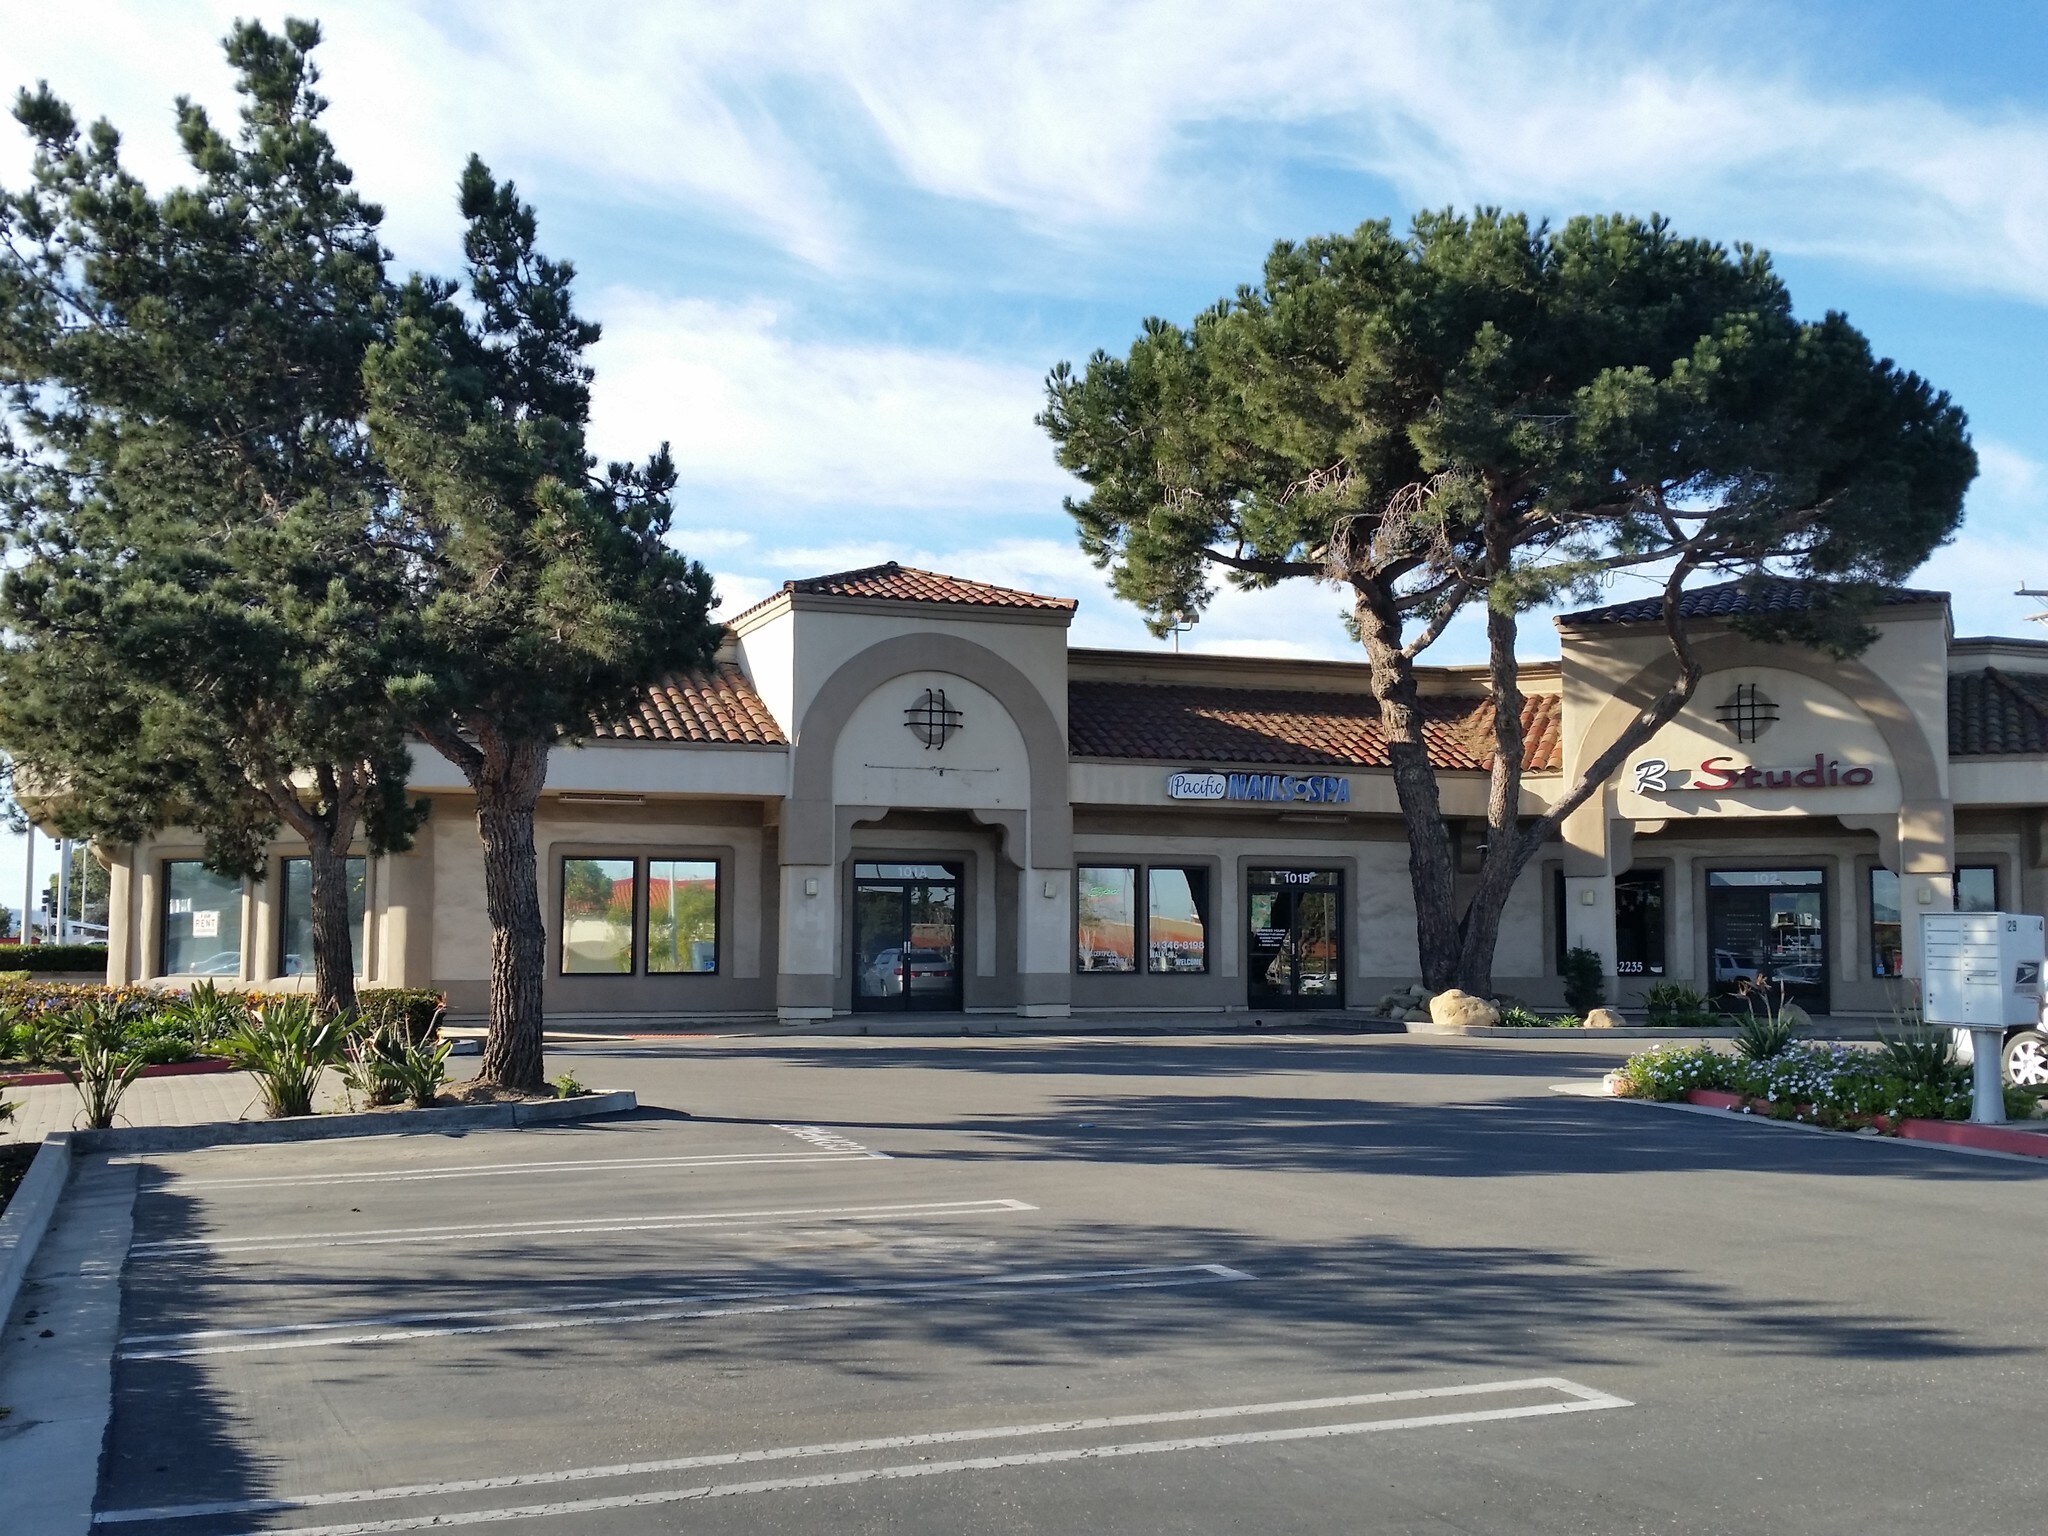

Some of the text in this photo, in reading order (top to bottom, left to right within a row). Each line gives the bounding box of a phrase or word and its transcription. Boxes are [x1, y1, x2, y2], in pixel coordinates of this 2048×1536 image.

[1693, 752, 1875, 791] Studio
[1173, 773, 1350, 803] Pacific NAILS SPA
[897, 866, 928, 877] 101A
[1285, 873, 1311, 884] 101B
[1754, 873, 1778, 884] 102
[195, 919, 216, 928] RENT
